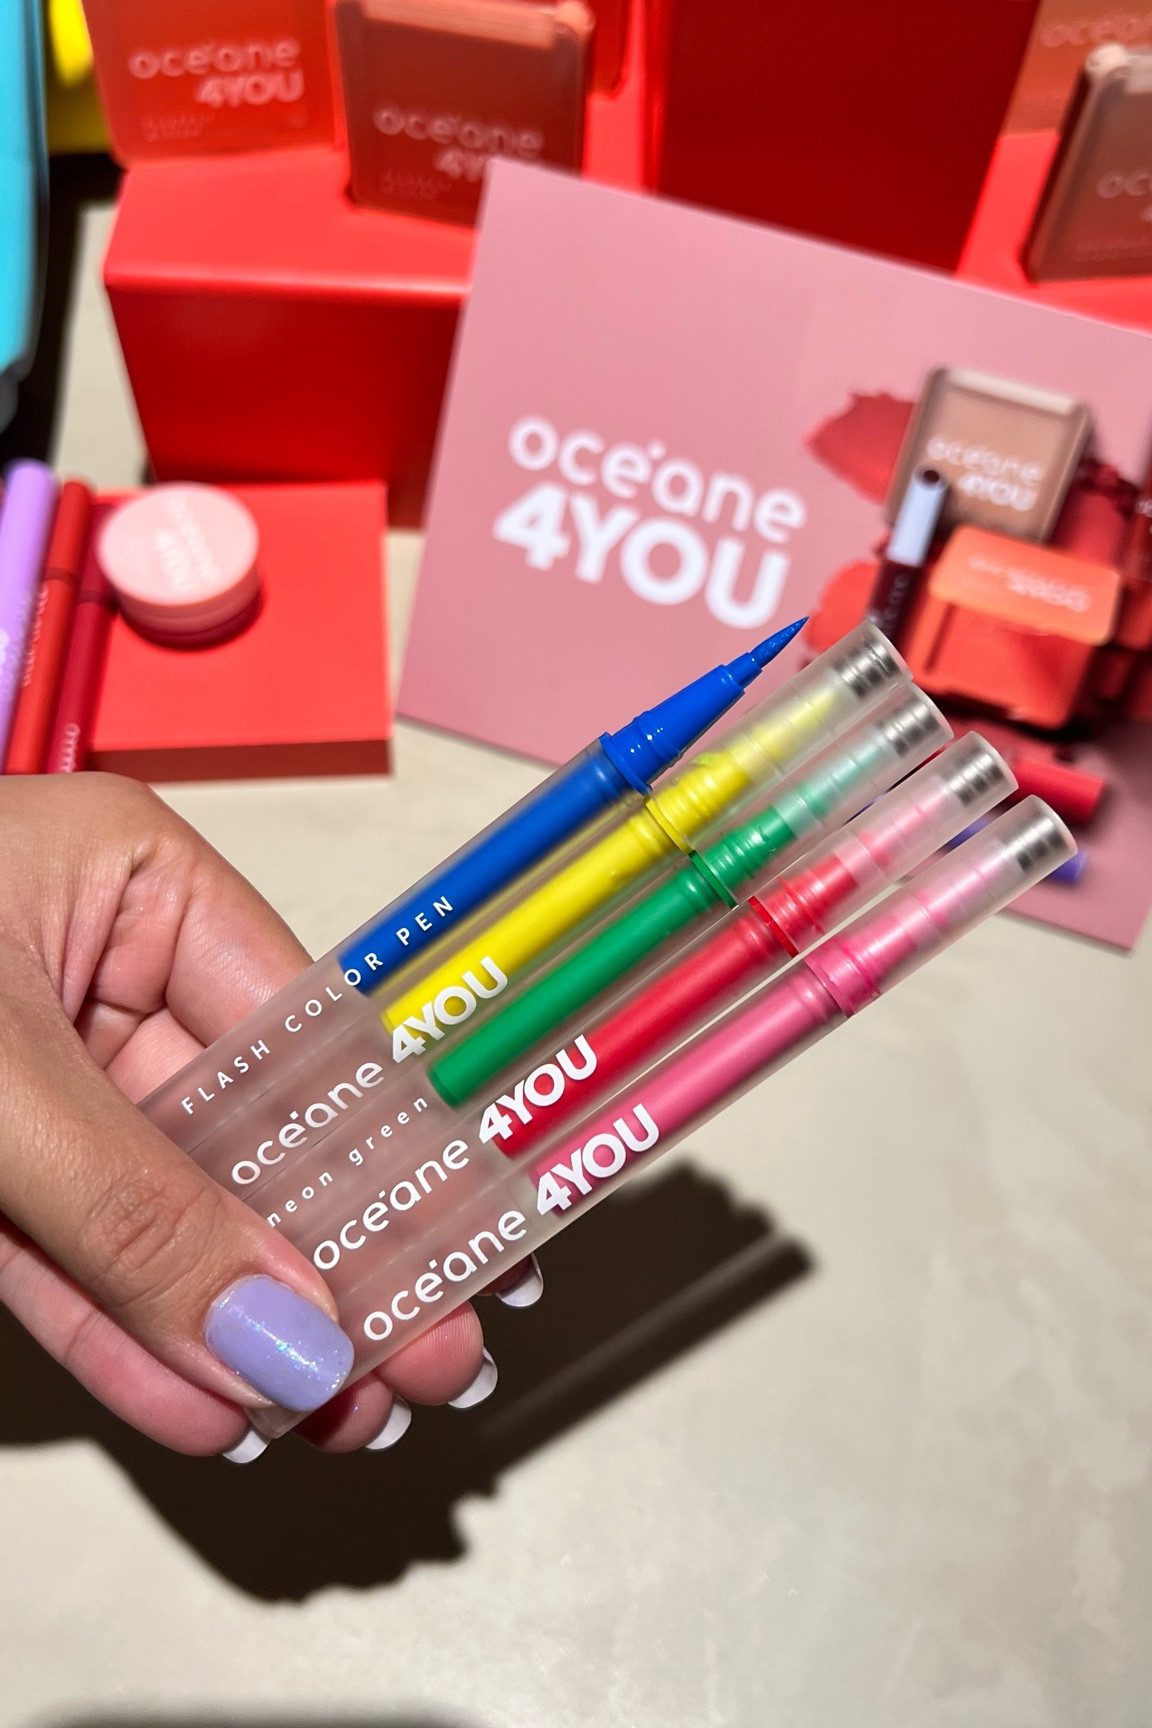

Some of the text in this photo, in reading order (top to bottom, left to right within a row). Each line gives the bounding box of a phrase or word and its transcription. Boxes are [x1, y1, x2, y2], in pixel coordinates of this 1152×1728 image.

[195, 68, 304, 107] 4YOU
[434, 147, 487, 182] 4Y
[508, 414, 806, 544] océane
[493, 481, 791, 630] 4YOU
[180, 895, 454, 1115] FLASH COLOR PEN
[231, 955, 508, 1185] océane 4YOU
[266, 1096, 428, 1228] neon green
[312, 1034, 598, 1271] océane 4YOU
[362, 1103, 660, 1342] océane 4YOU
